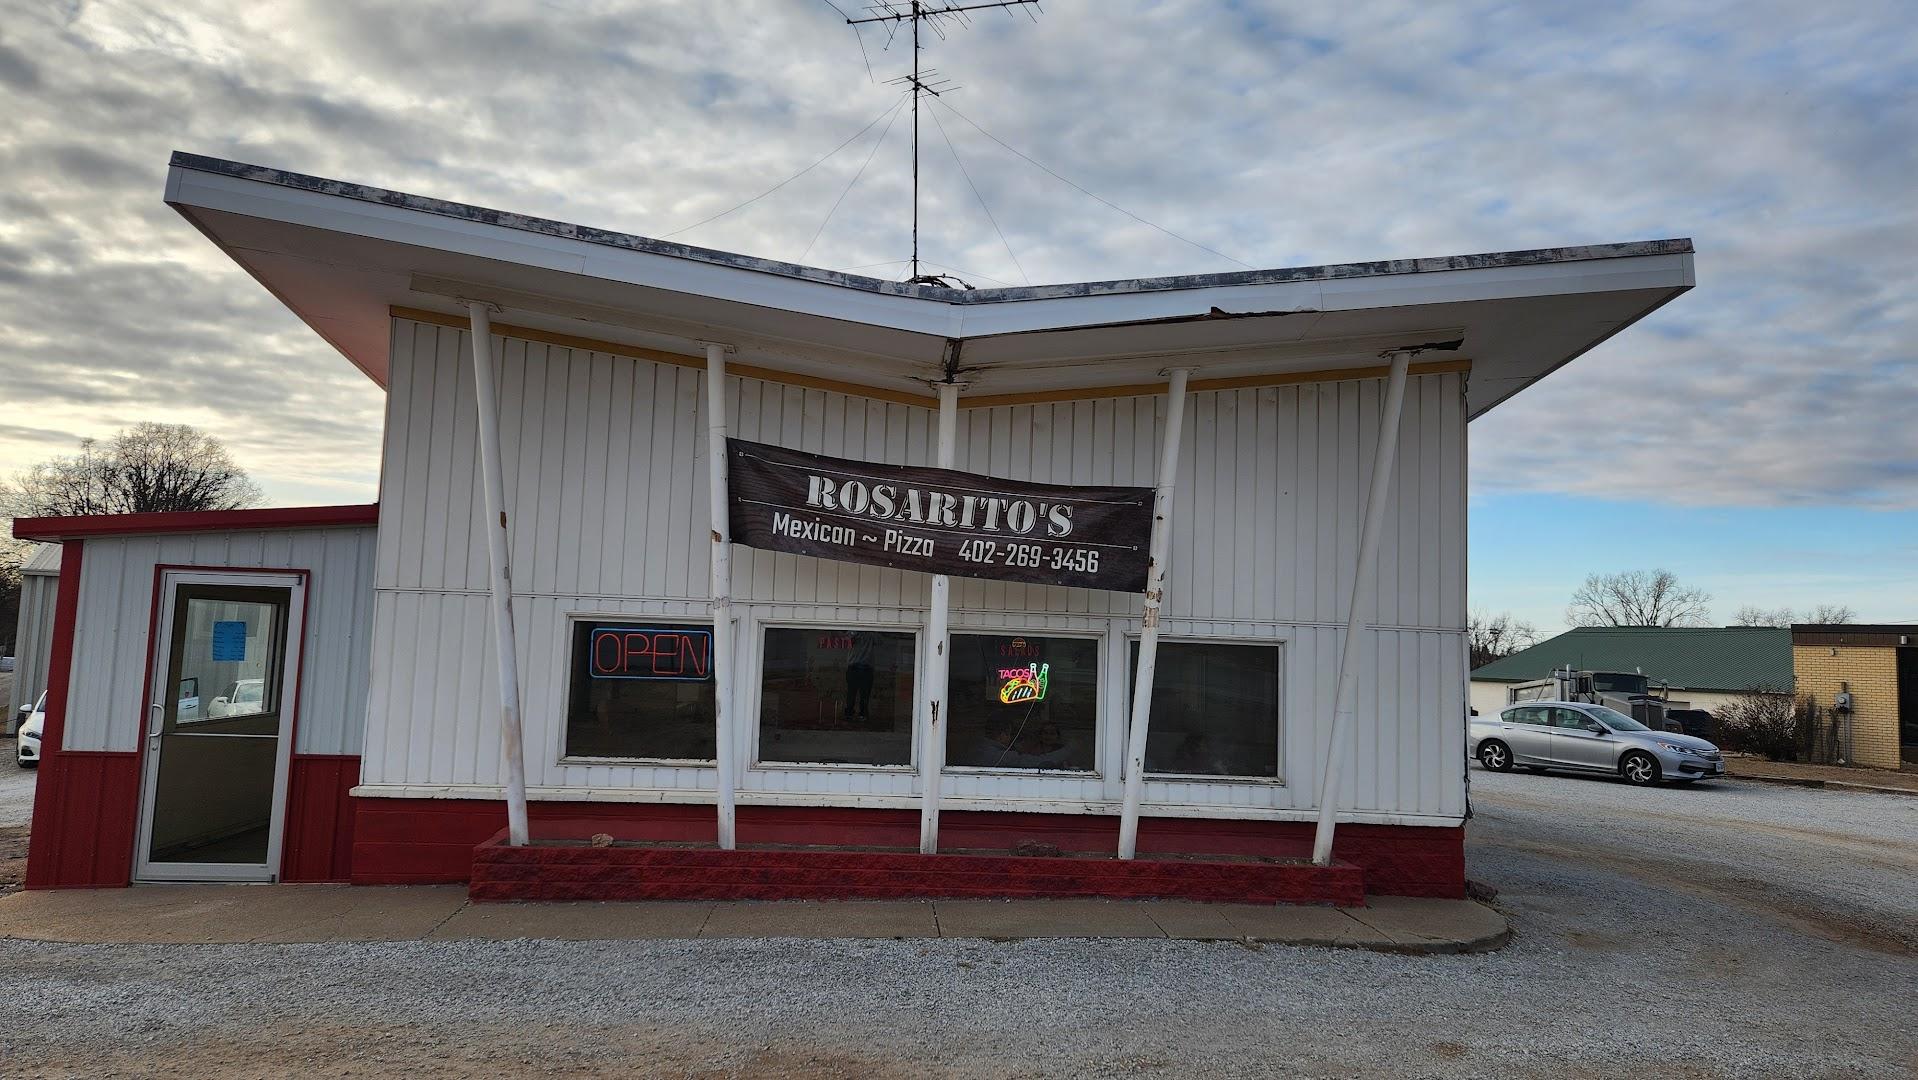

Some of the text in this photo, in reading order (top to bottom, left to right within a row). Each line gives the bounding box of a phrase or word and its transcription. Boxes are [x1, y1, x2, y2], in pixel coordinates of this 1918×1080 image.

[806, 475, 1074, 538] ROSARITO'S
[772, 512, 855, 547] Mexican
[883, 529, 935, 558] Pizza
[958, 539, 1099, 574] 402-269-3456
[596, 633, 707, 676] OPEN
[998, 668, 1030, 680] TACOS
